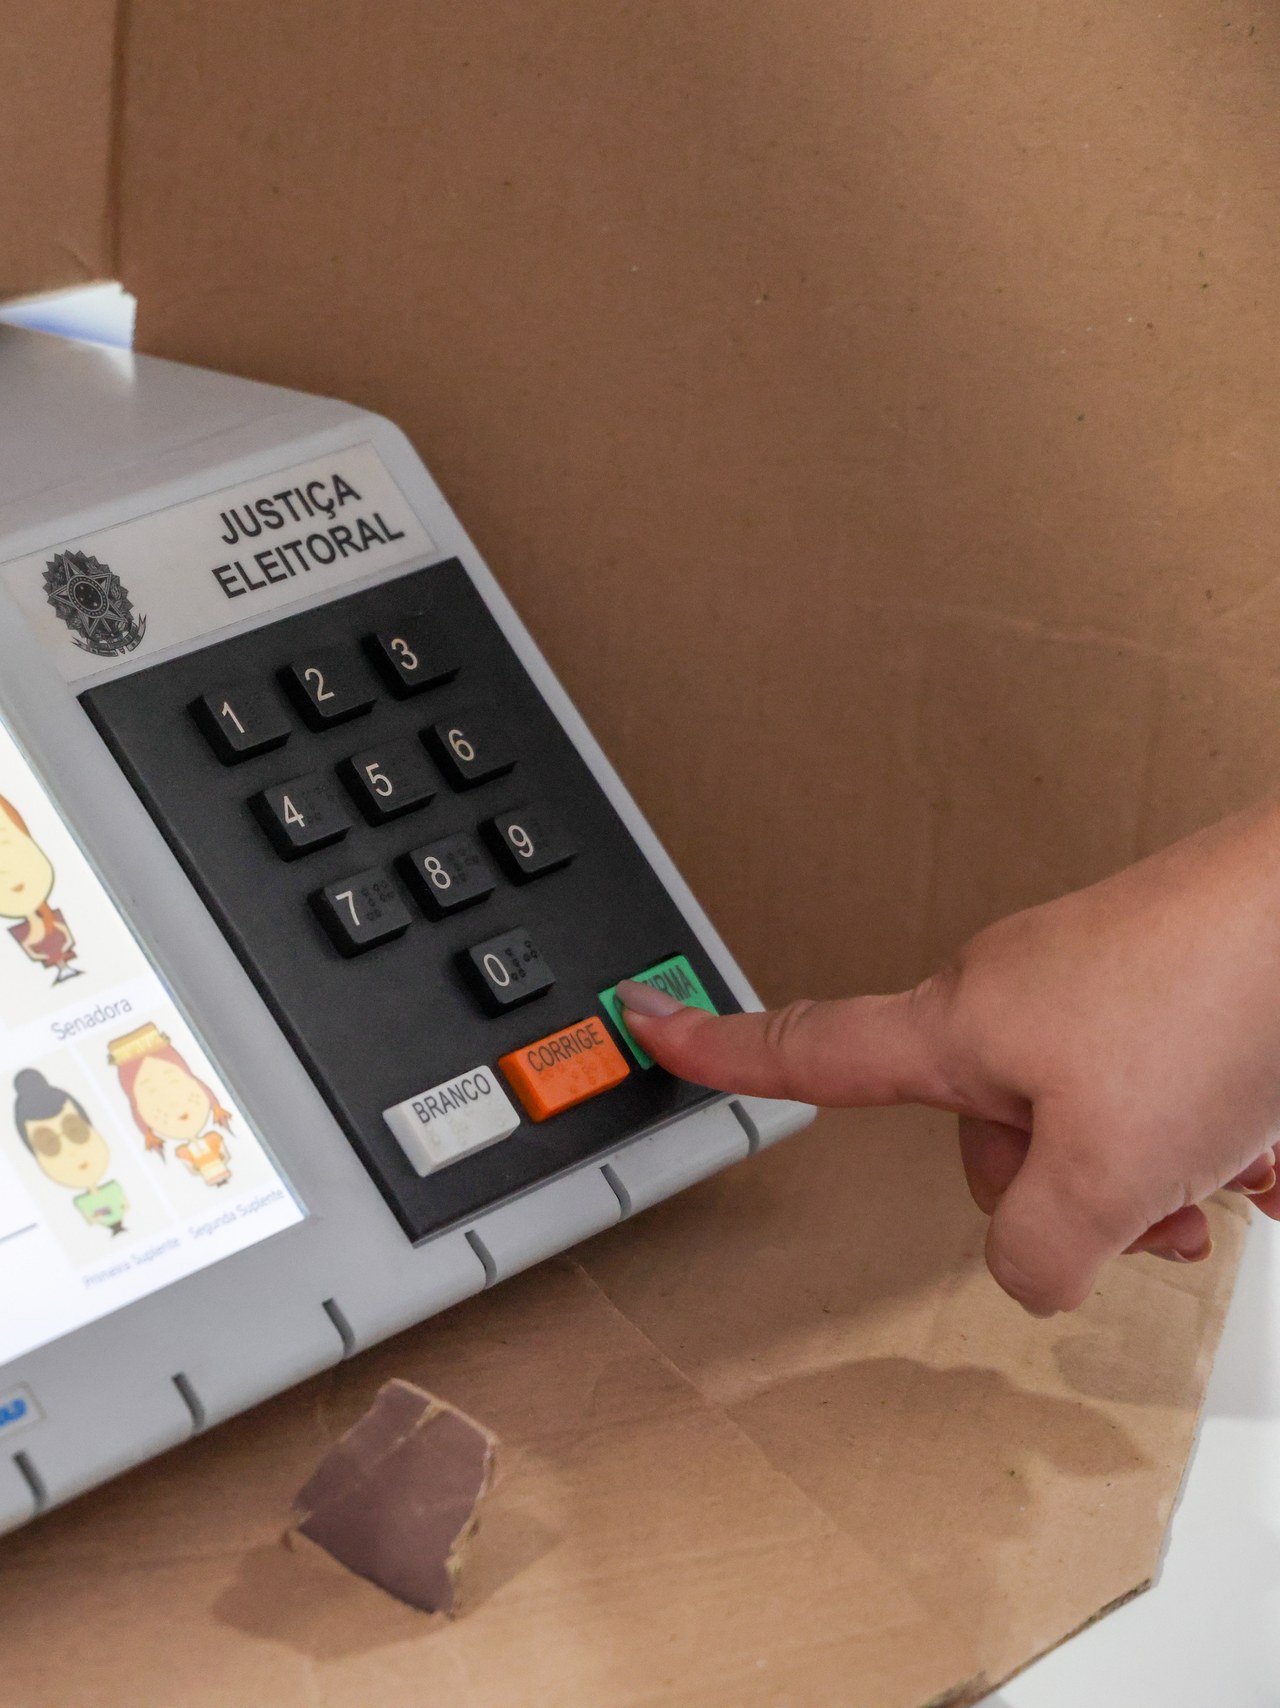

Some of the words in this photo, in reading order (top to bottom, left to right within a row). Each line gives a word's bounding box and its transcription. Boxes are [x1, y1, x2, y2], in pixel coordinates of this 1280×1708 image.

[219, 473, 362, 545] JUSTIÇA
[211, 512, 405, 599] ELEITORAL
[221, 701, 245, 735] 1
[304, 667, 335, 701] 2
[391, 638, 418, 670] 3
[282, 795, 305, 828] 4
[365, 763, 393, 797] 5
[447, 728, 475, 761] 6
[335, 890, 361, 926] 7
[423, 856, 451, 889] 8
[507, 824, 534, 858] 9
[482, 953, 510, 987] 0
[51, 998, 133, 1041] Senadora
[527, 1023, 604, 1073] CORRIGE
[412, 1073, 492, 1126] BRANCO
[236, 1187, 285, 1217] Suplente
